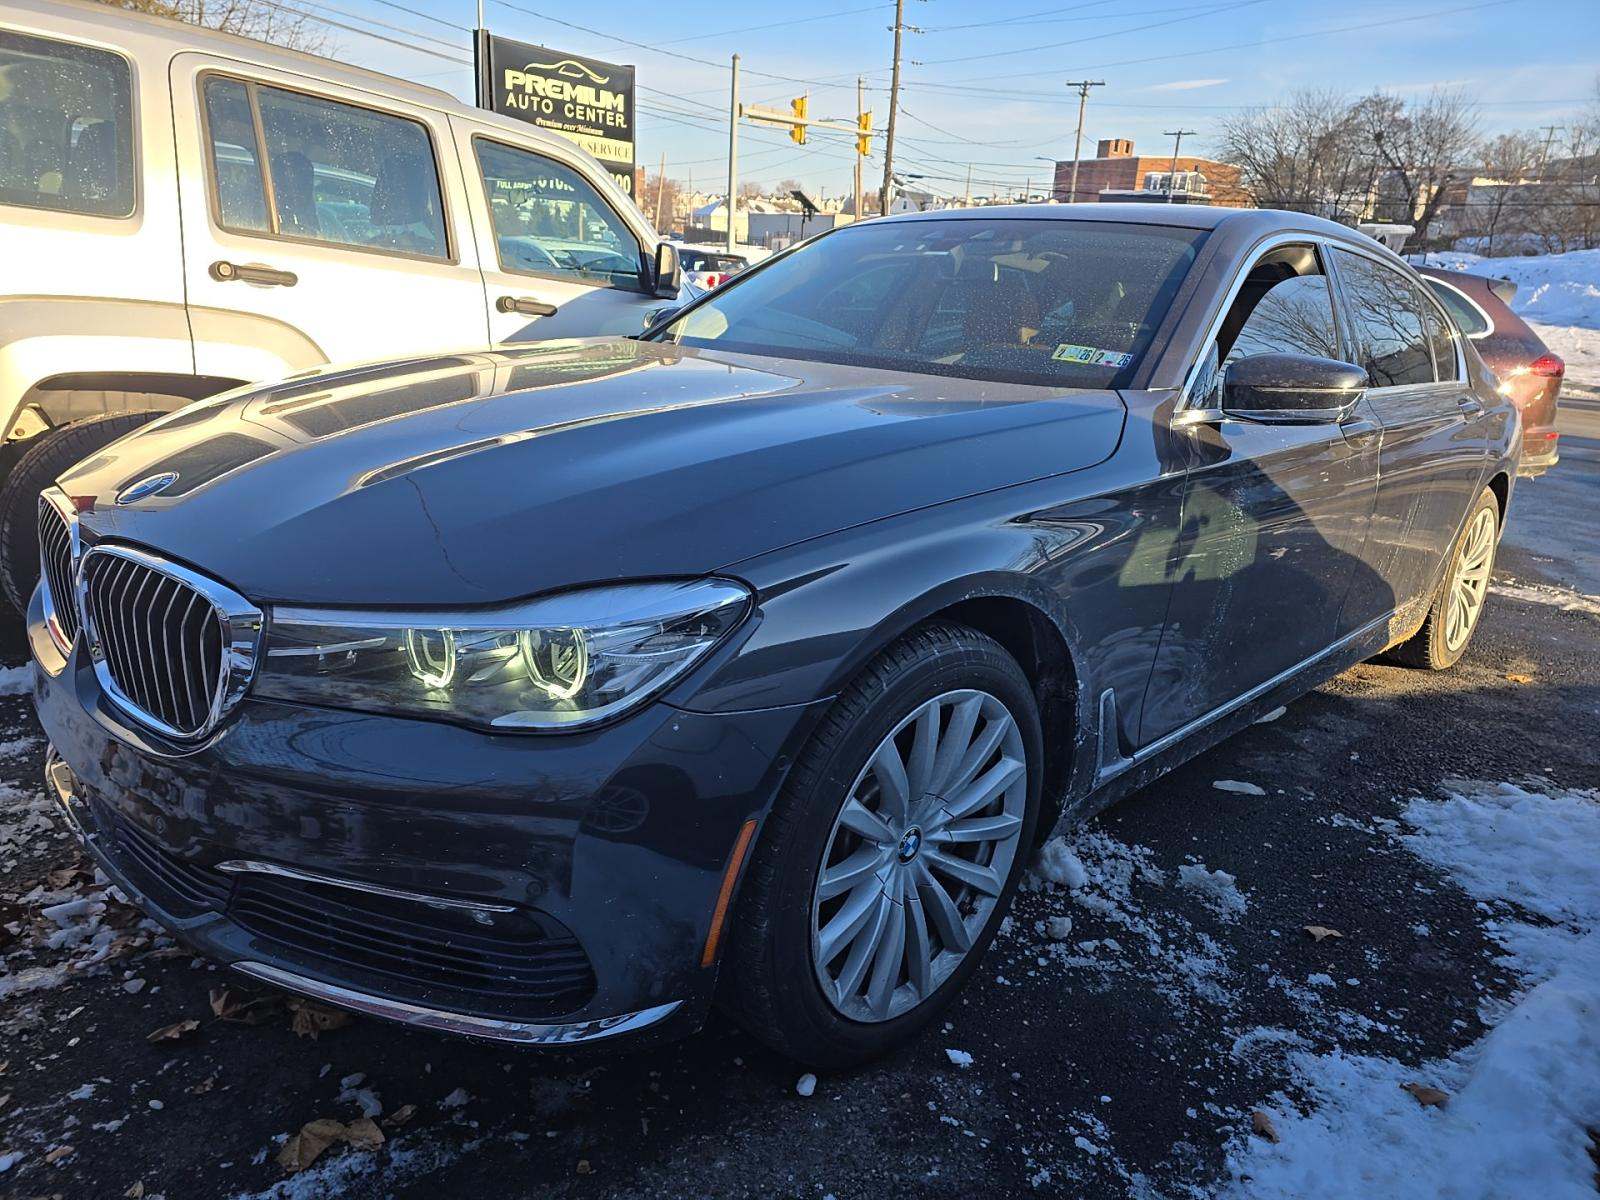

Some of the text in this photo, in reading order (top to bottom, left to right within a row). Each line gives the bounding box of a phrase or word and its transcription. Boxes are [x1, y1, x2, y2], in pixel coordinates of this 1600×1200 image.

[504, 69, 625, 113] PREMIUM
[505, 92, 627, 128] AUTO CENTER
[587, 142, 630, 159] SERVICE
